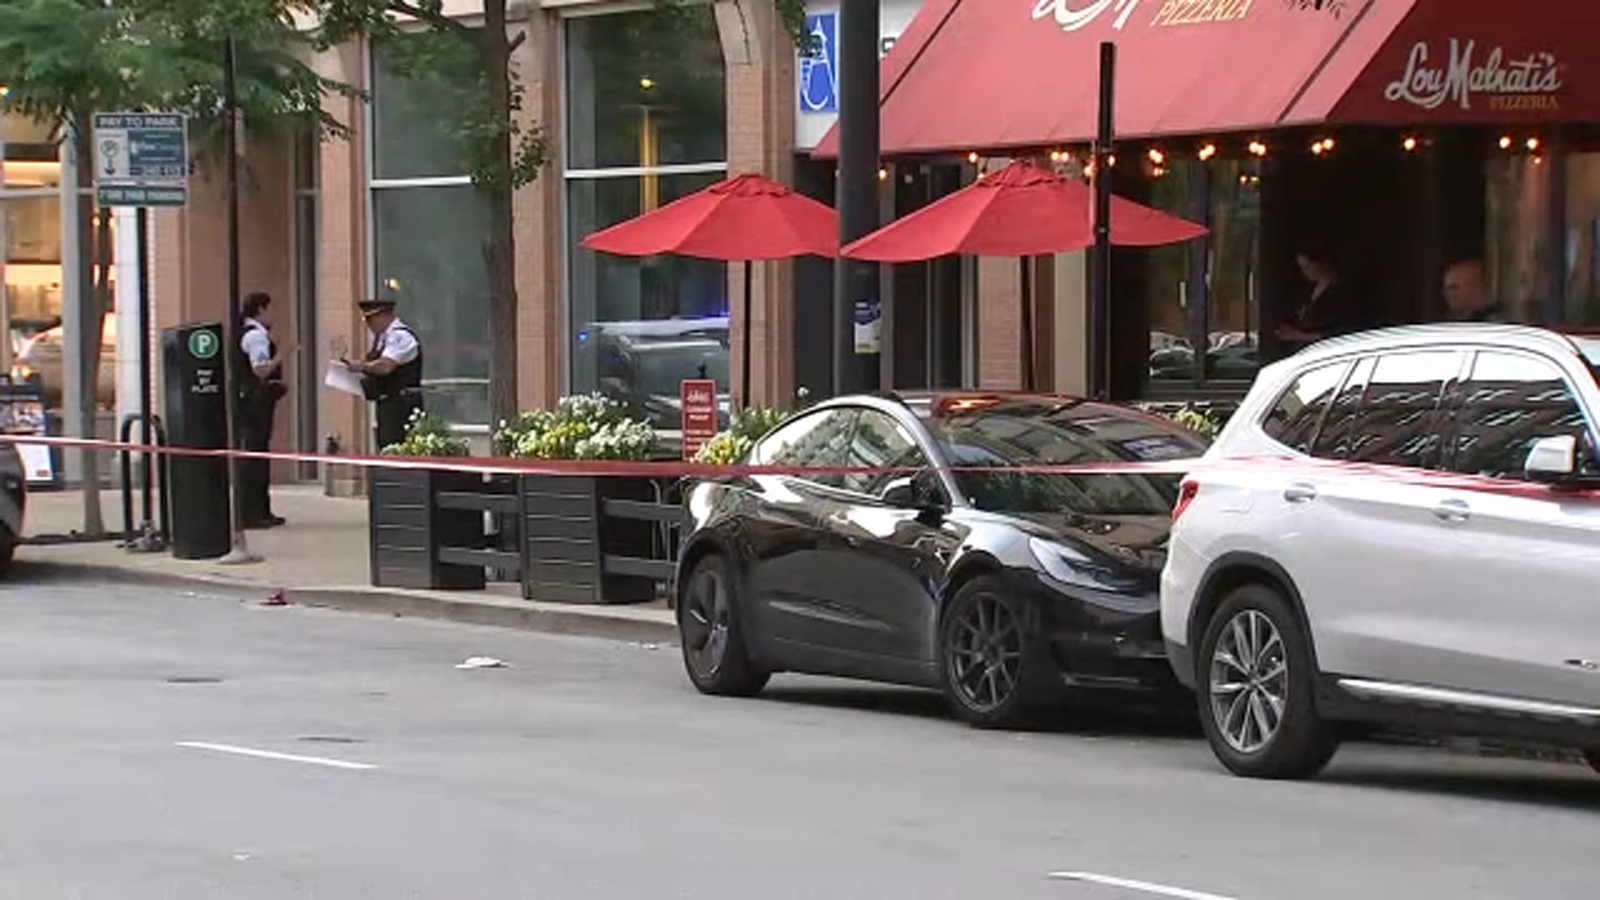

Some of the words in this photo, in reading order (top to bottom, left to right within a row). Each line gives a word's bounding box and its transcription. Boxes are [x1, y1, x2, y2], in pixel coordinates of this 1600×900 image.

[1384, 42, 1446, 109] Lou
[1440, 38, 1562, 109] Malnati's
[1489, 94, 1560, 110] PIZZERIA
[99, 116, 122, 127] PAY
[125, 116, 143, 127] TO
[145, 116, 177, 127] PARK
[198, 334, 212, 353] P
